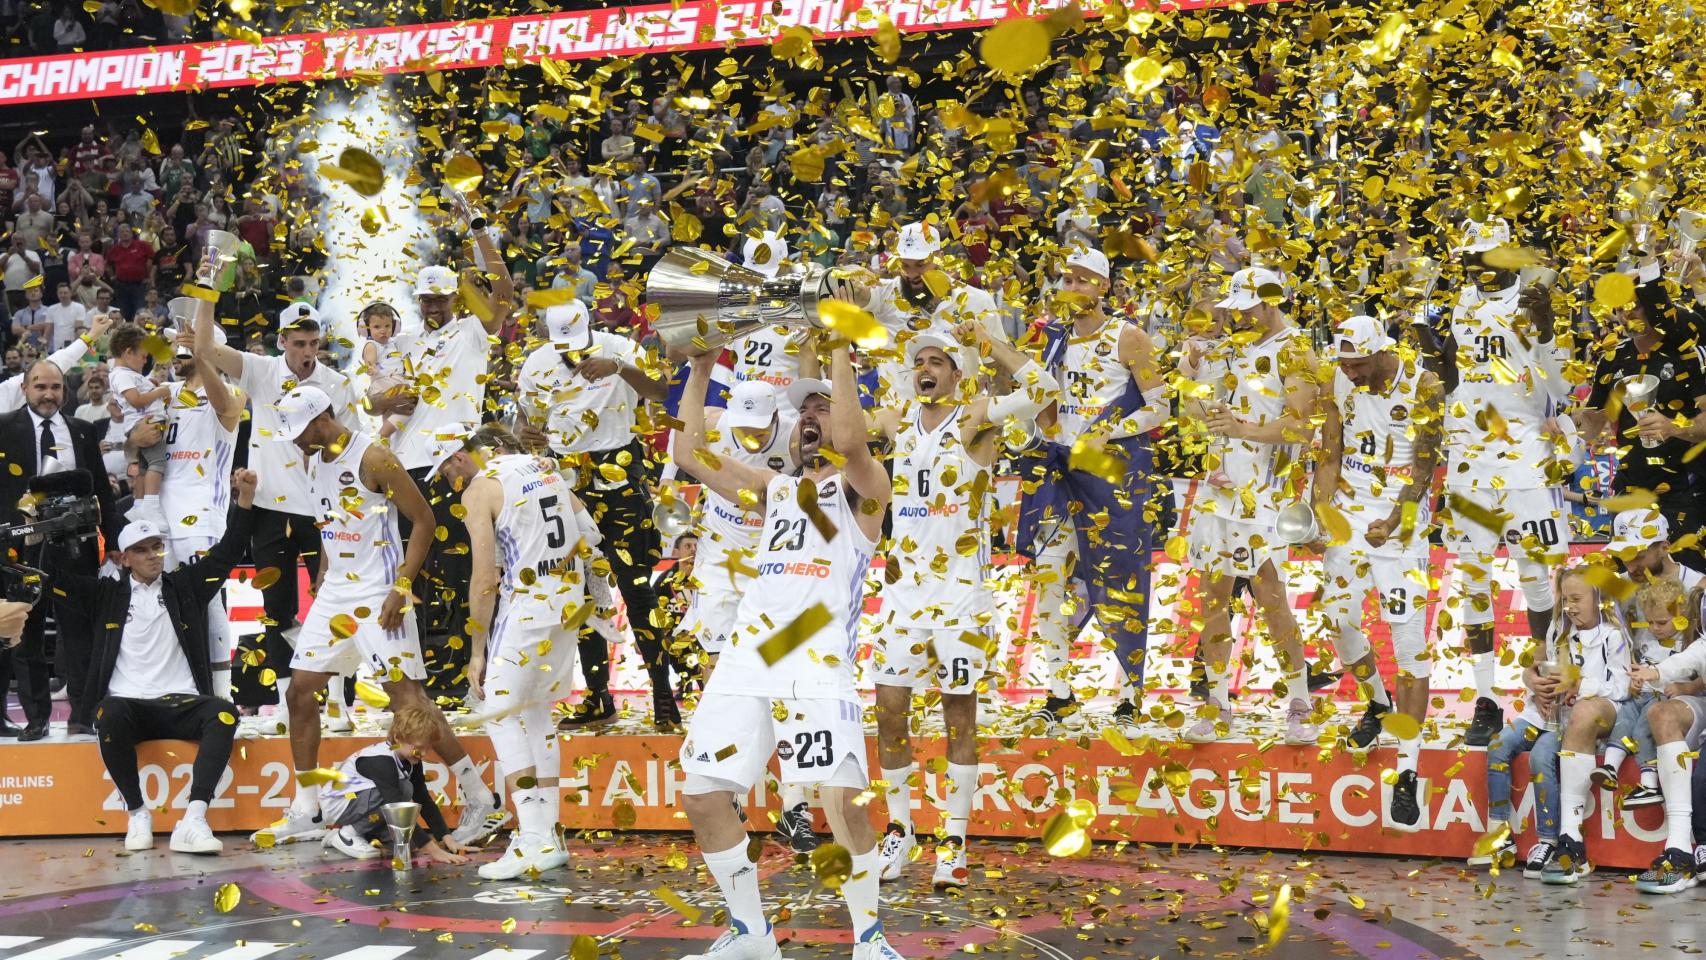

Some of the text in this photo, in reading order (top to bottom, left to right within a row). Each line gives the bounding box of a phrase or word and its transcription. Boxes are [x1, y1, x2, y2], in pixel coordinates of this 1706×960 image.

[0, 49, 184, 97] CHAMPION
[196, 40, 304, 82] 2023
[322, 25, 493, 70] TURKISH
[507, 9, 698, 56] AIRLINES
[745, 340, 772, 366] 22
[1475, 336, 1506, 362] 30
[918, 469, 930, 497] 6
[11, 526, 35, 536] RONIN
[539, 494, 566, 549] 5
[769, 518, 807, 552] 23
[953, 657, 969, 686] 6
[795, 730, 833, 768] 23
